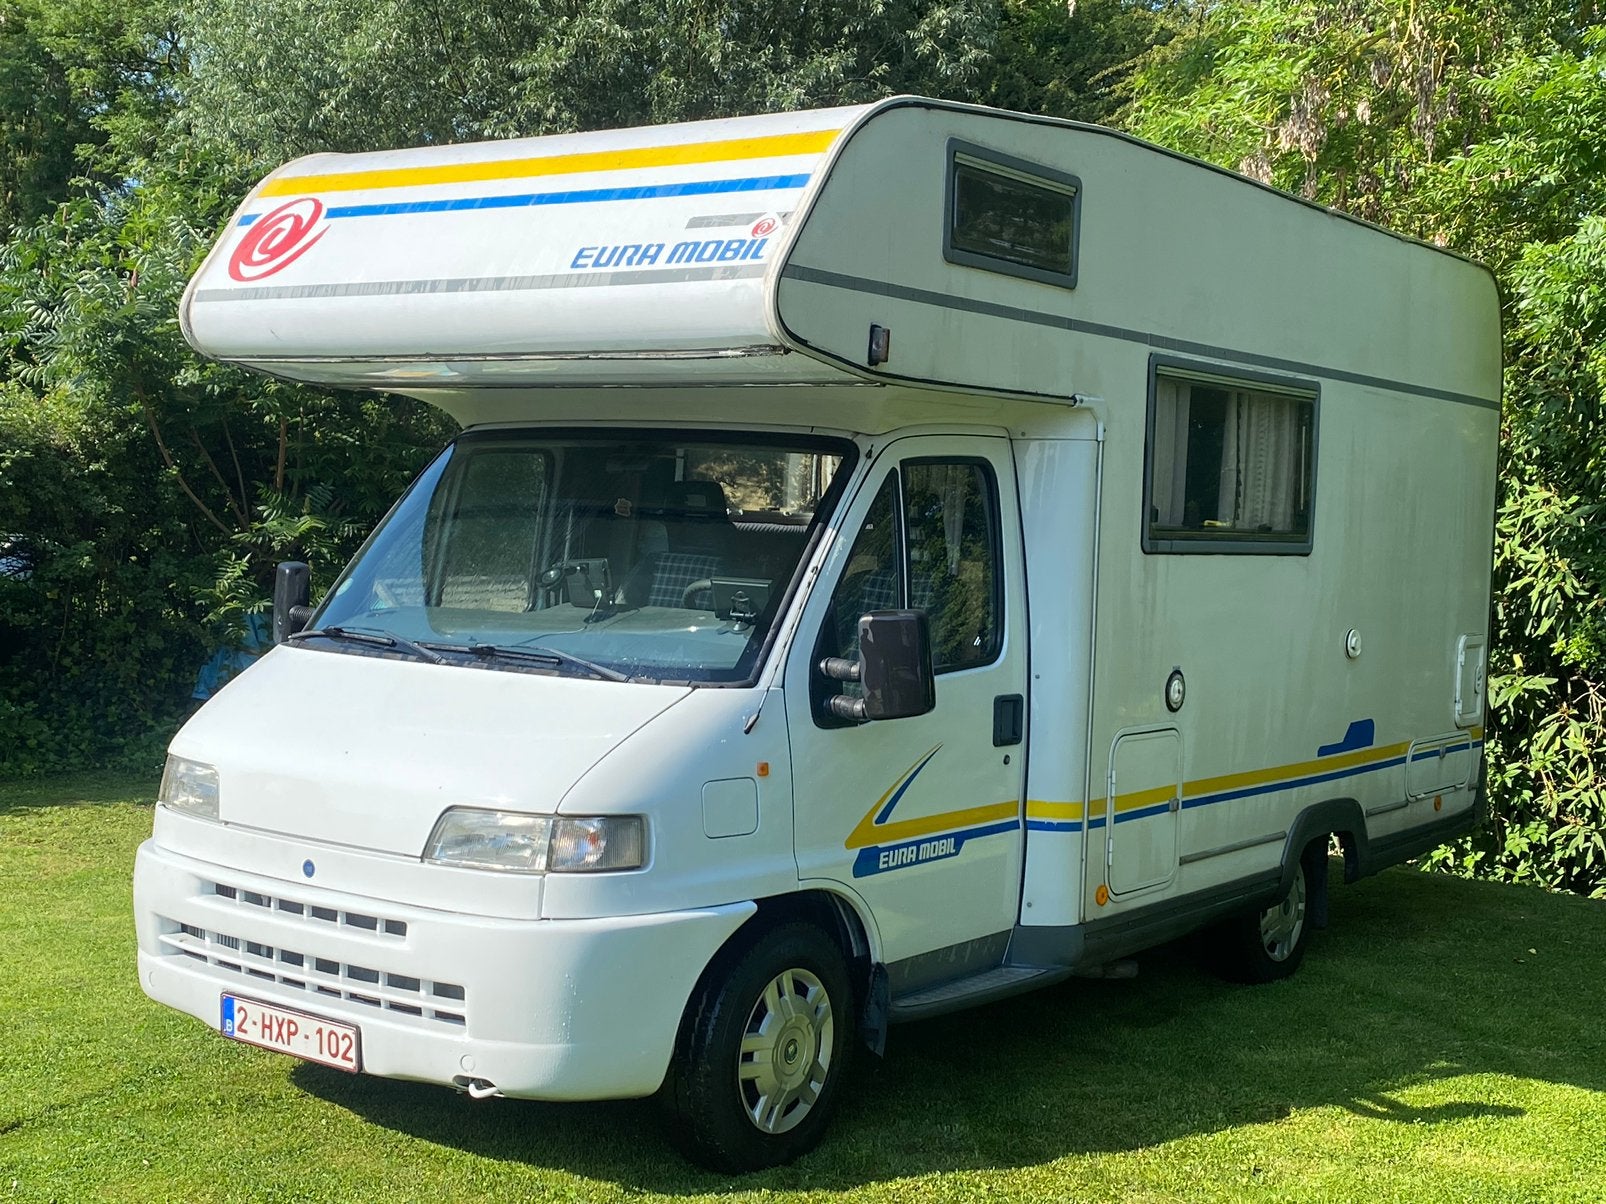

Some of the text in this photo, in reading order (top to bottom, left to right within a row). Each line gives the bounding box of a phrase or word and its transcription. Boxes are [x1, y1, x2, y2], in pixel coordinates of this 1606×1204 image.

[570, 238, 769, 269] EURA MOBIL
[879, 837, 956, 869] EURA MOBIL
[225, 1018, 233, 1032] B
